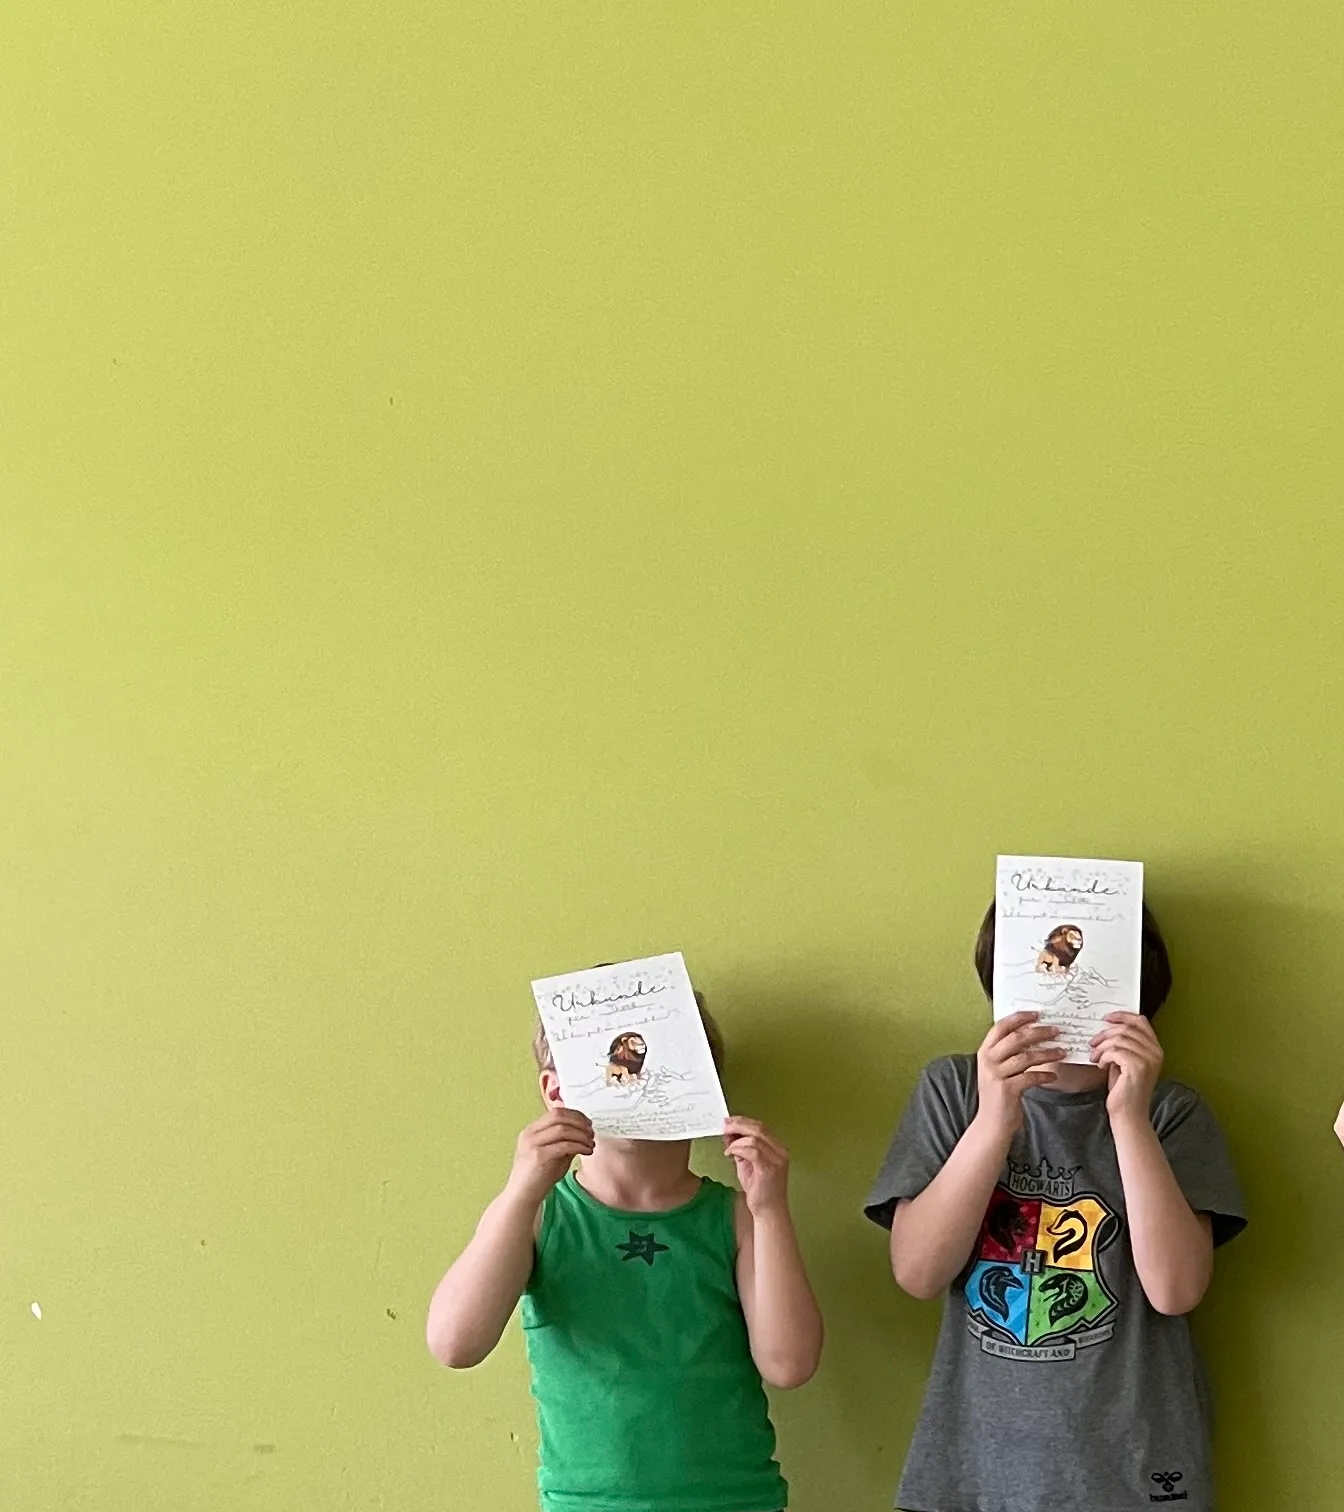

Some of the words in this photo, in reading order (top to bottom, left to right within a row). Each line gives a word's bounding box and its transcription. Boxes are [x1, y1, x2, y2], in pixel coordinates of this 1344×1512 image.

[1011, 873, 1118, 895] Urkunde
[552, 981, 665, 1012] Urkunde
[1011, 1174, 1072, 1197] HOGWARTS
[1025, 1250, 1042, 1272] H
[1050, 1347, 1071, 1358] AND
